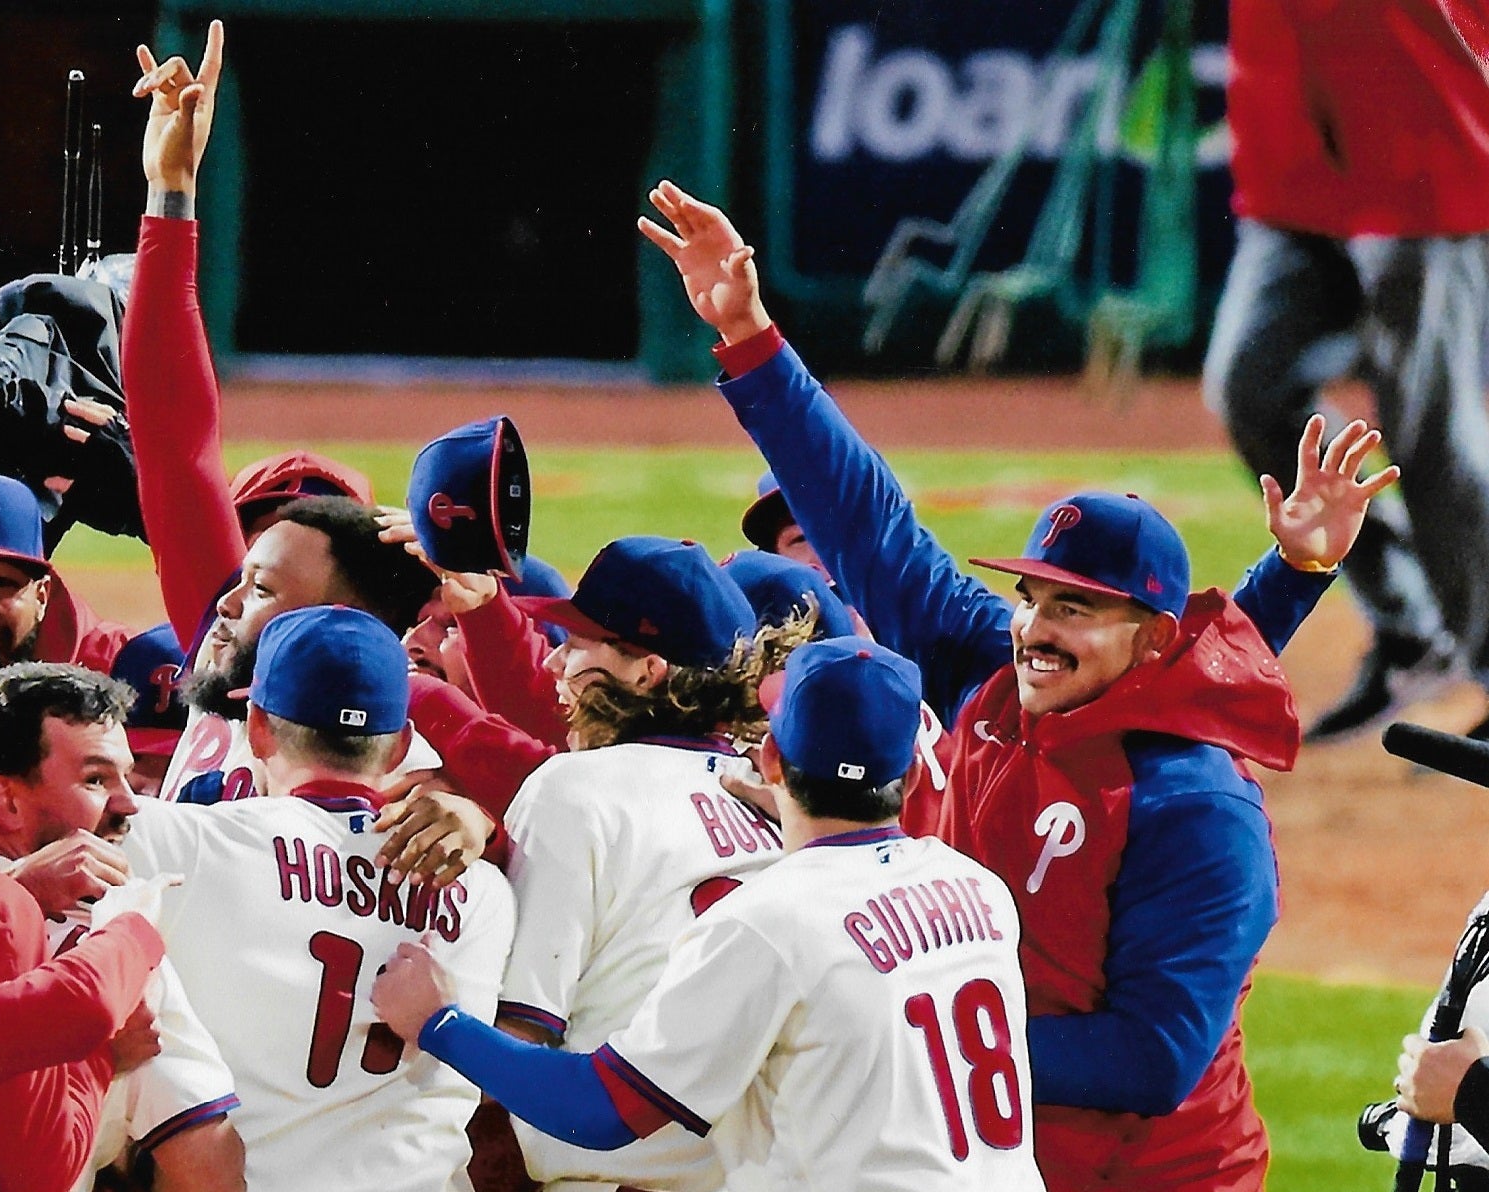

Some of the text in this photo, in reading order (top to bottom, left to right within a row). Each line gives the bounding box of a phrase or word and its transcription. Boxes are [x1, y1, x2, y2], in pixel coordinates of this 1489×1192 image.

[1042, 505, 1082, 548] P
[690, 792, 783, 858] BOH
[1026, 801, 1086, 894] P
[844, 877, 1003, 974] GUTHRIE
[905, 978, 1023, 1162] 18
